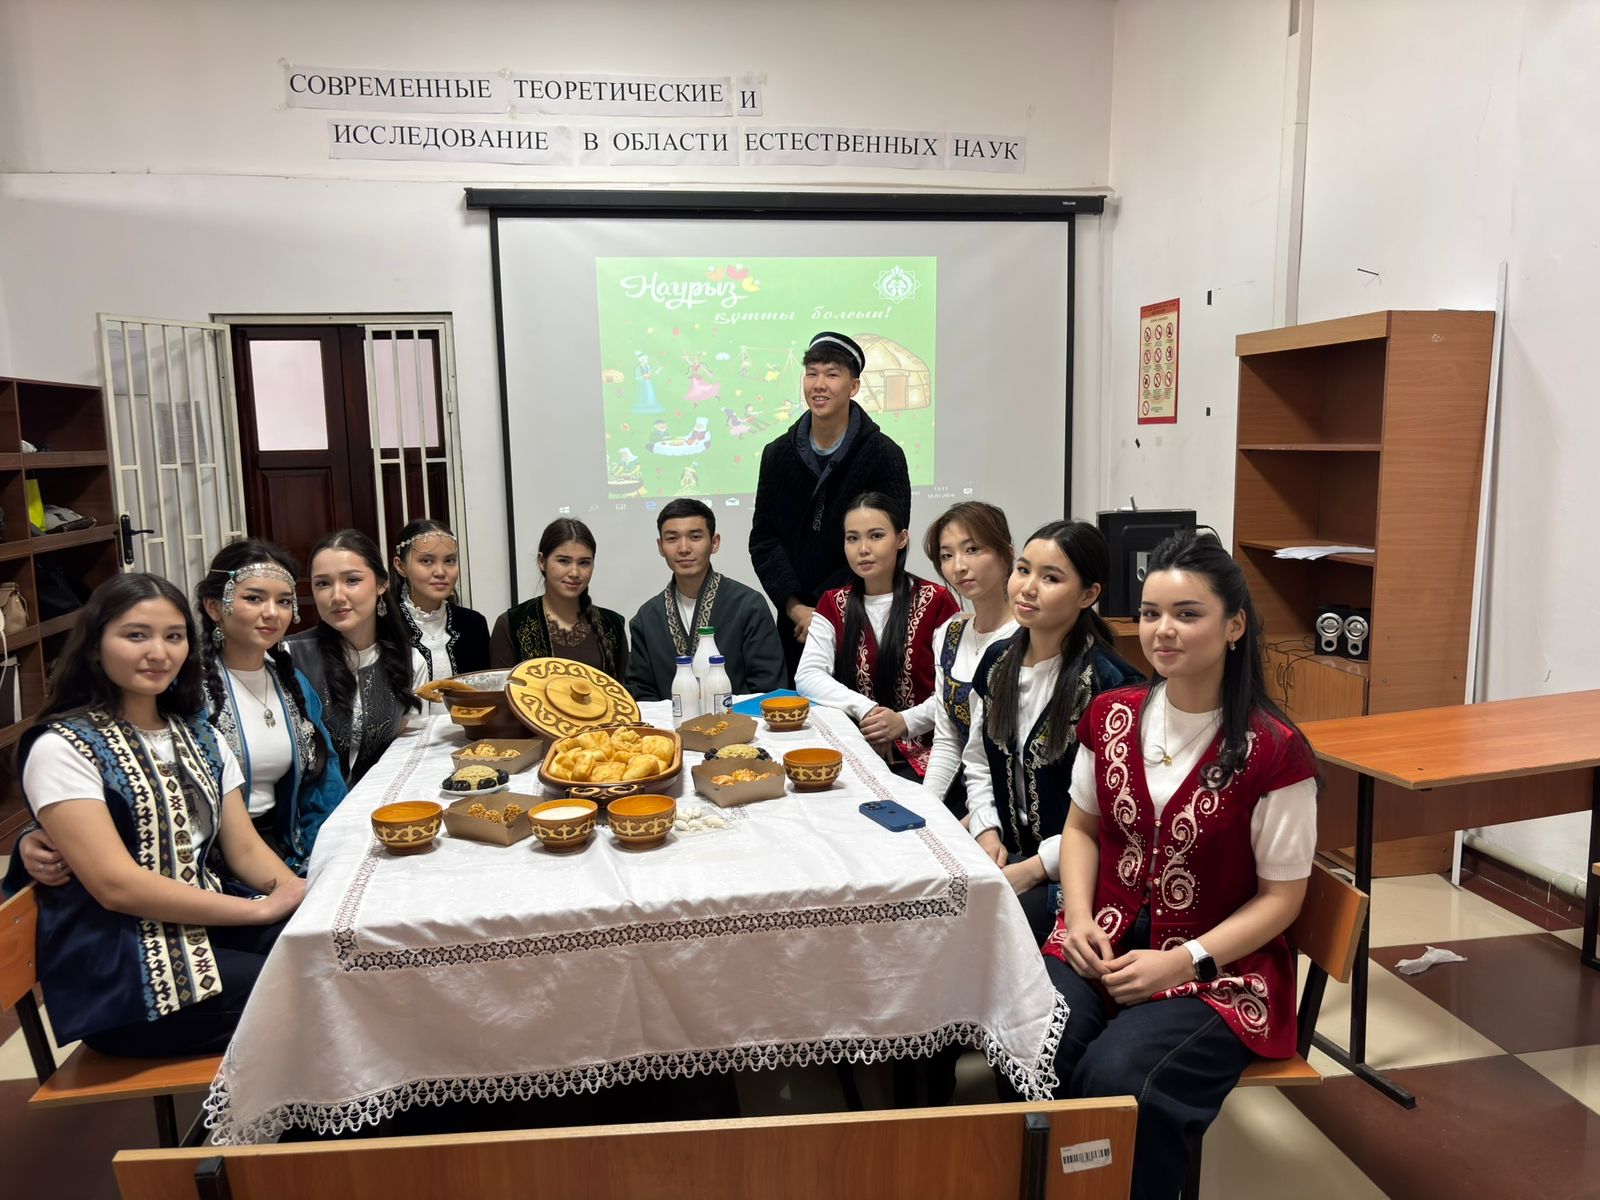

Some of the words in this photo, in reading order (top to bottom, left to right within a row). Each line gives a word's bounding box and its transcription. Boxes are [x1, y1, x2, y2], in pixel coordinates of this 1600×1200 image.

[289, 73, 493, 99] СОВРЕМЕННЫЕ
[513, 78, 724, 104] ТЕОРЕТИЧЕСКИЕ
[740, 90, 758, 109] И
[333, 124, 549, 151] ИССЛЕДОВАНИЕ
[583, 132, 599, 151] В
[612, 132, 729, 152] ОБЛАСТИ
[744, 132, 938, 156] ЕСТЕСТВЕННЫХ
[953, 138, 1019, 161] НАУК
[620, 271, 749, 310] Наурыз
